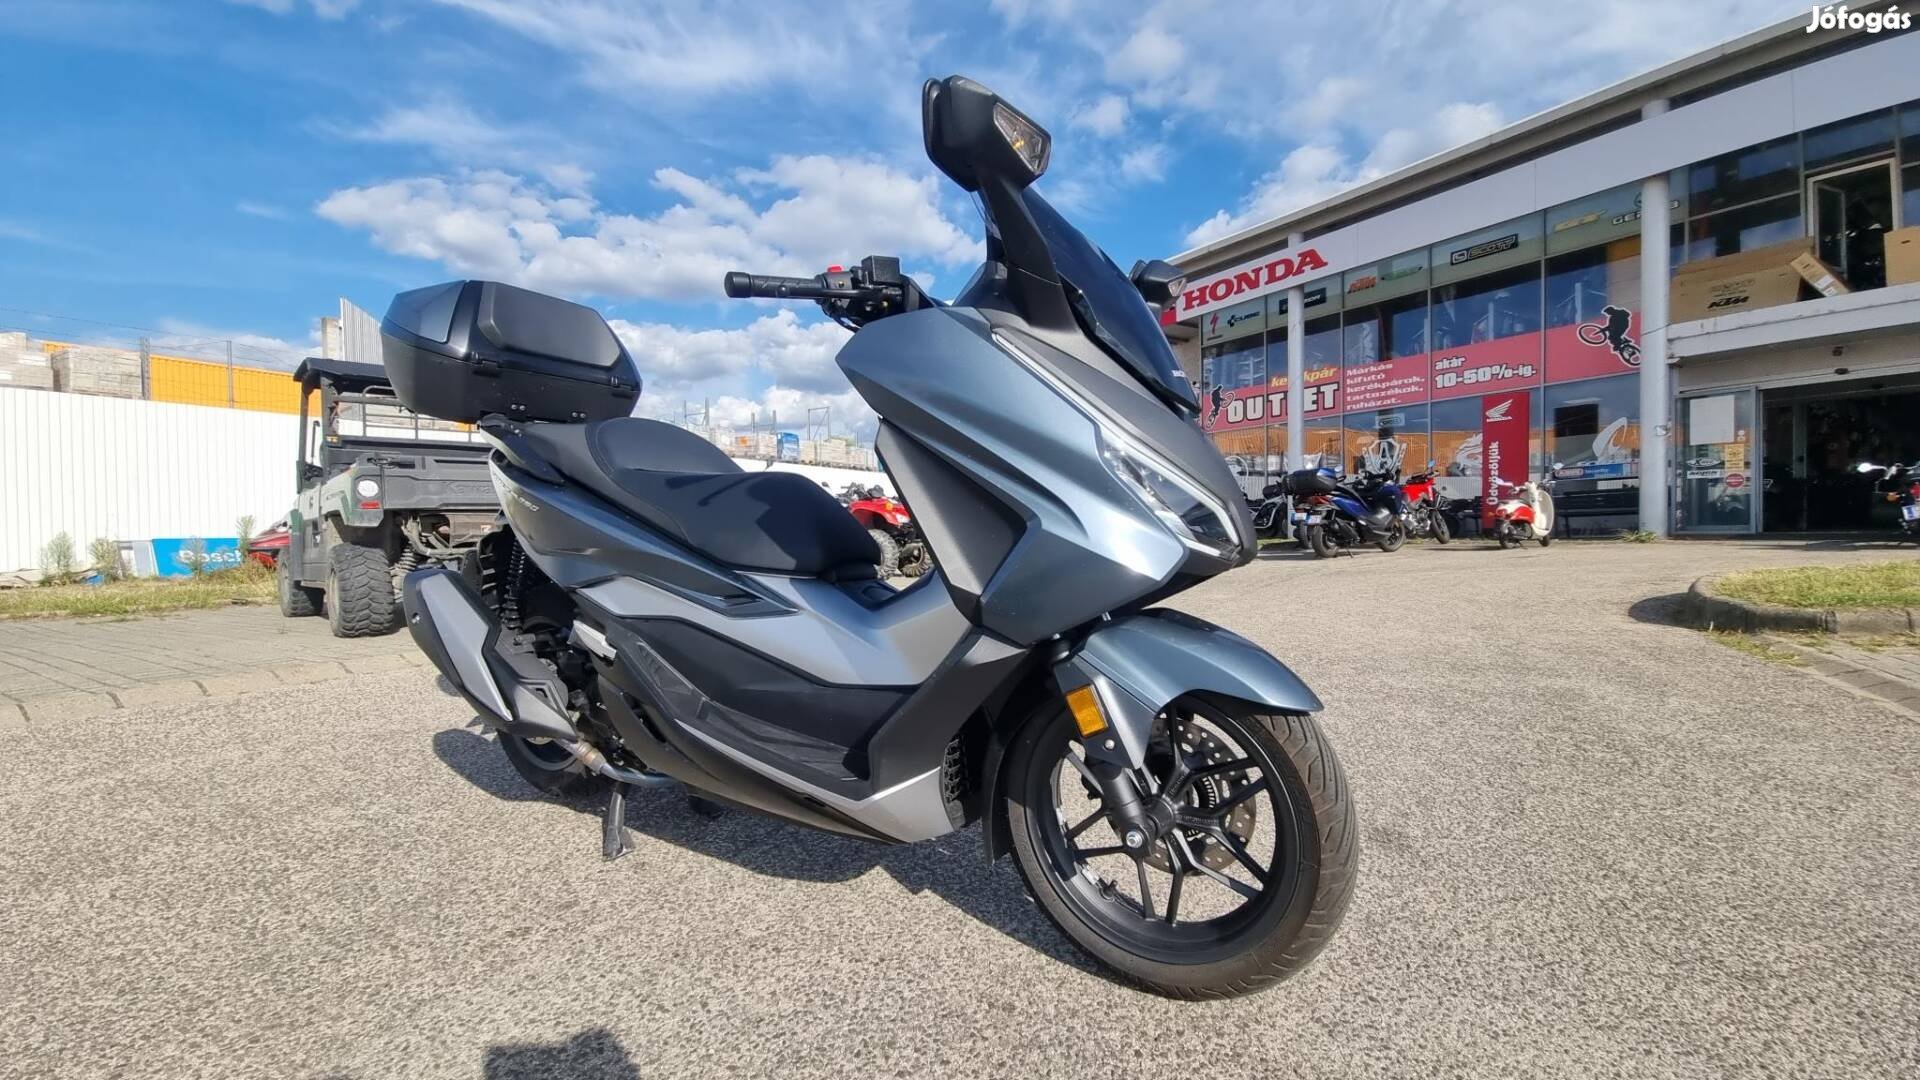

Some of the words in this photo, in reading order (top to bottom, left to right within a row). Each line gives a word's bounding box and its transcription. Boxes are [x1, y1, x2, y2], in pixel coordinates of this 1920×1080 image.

[1183, 249, 1328, 311] HONDA
[1271, 366, 1338, 388] kekpár
[1435, 356, 1466, 370] akár
[1227, 382, 1339, 424] OUTET
